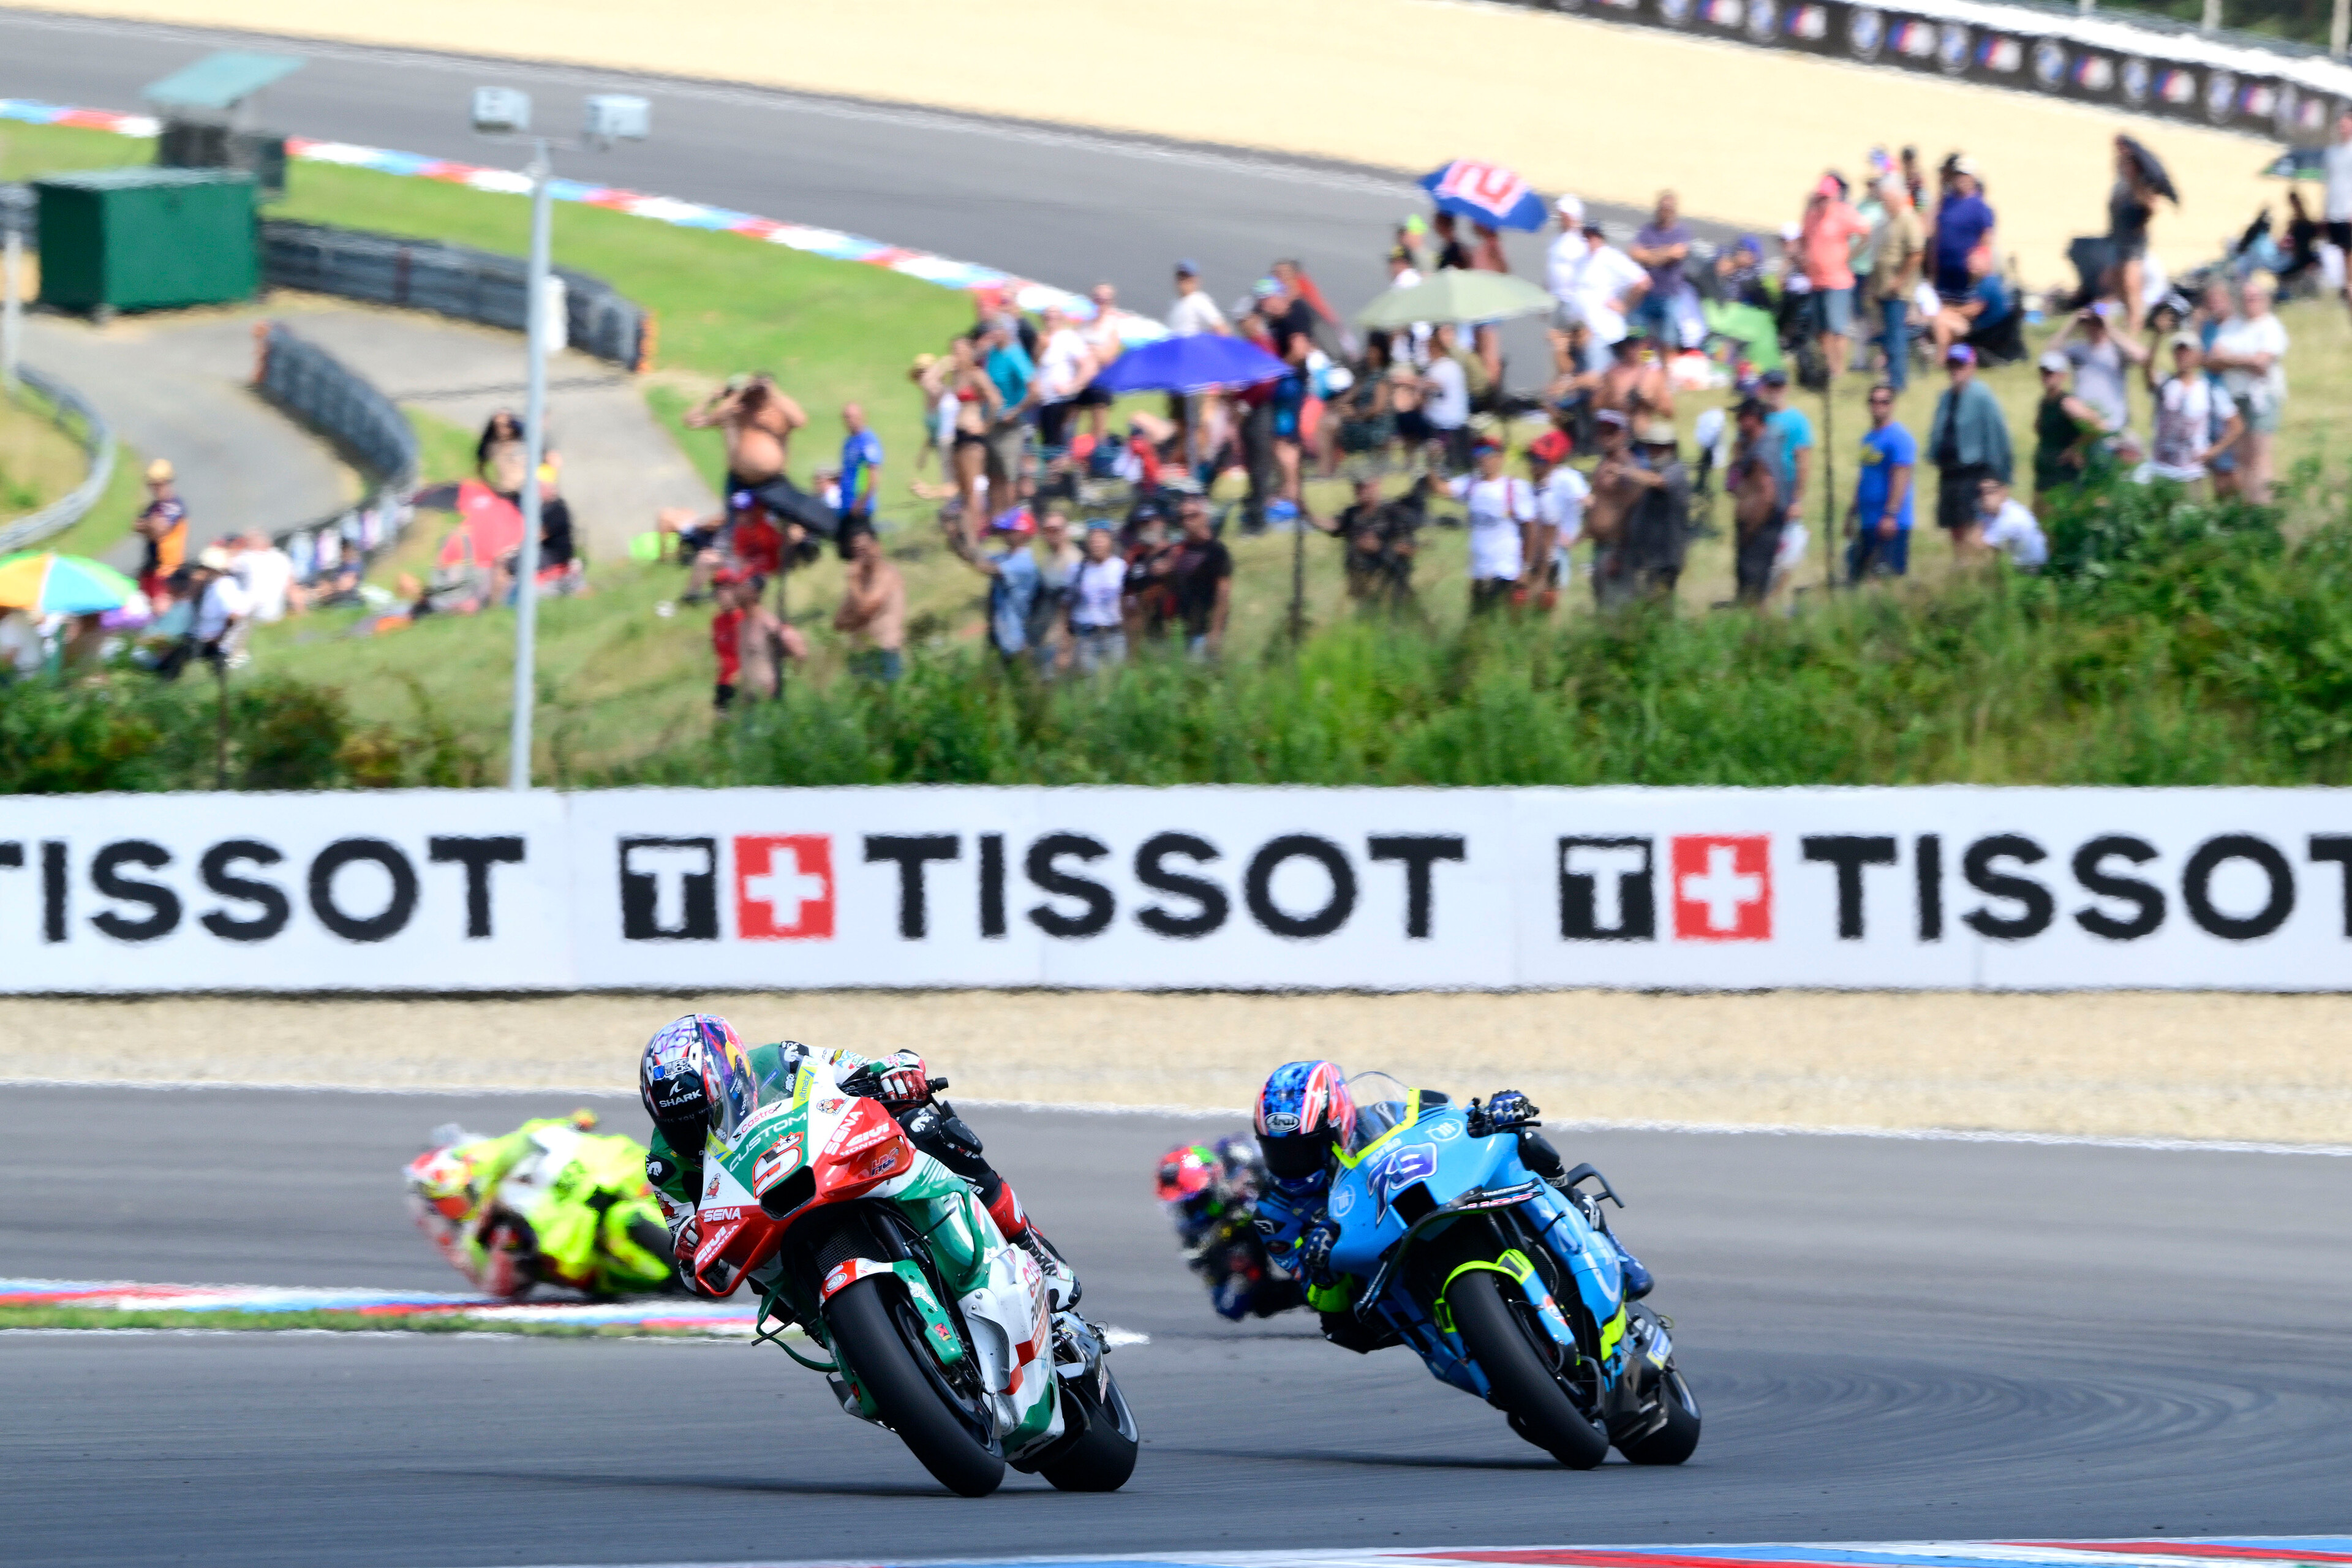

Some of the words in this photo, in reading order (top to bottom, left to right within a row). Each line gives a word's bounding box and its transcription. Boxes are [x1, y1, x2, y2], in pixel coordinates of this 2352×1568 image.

[0, 835, 525, 942] ISSOT
[863, 832, 1465, 940] TISSOT
[659, 1088, 703, 1108] SHARK
[799, 1076, 811, 1101] ultimate
[741, 1105, 778, 1134] Castrol
[824, 1111, 864, 1155] SENA
[846, 1123, 890, 1147] GIVI
[1267, 1115, 1295, 1128] Arai
[729, 1112, 807, 1172] CUSTOM
[839, 1136, 888, 1157] HONDA
[752, 1131, 805, 1200] 5
[1366, 1142, 1438, 1227] 79
[704, 1207, 742, 1223] SENA
[695, 1226, 727, 1265] GIVI
[704, 1224, 740, 1263] HONDA
